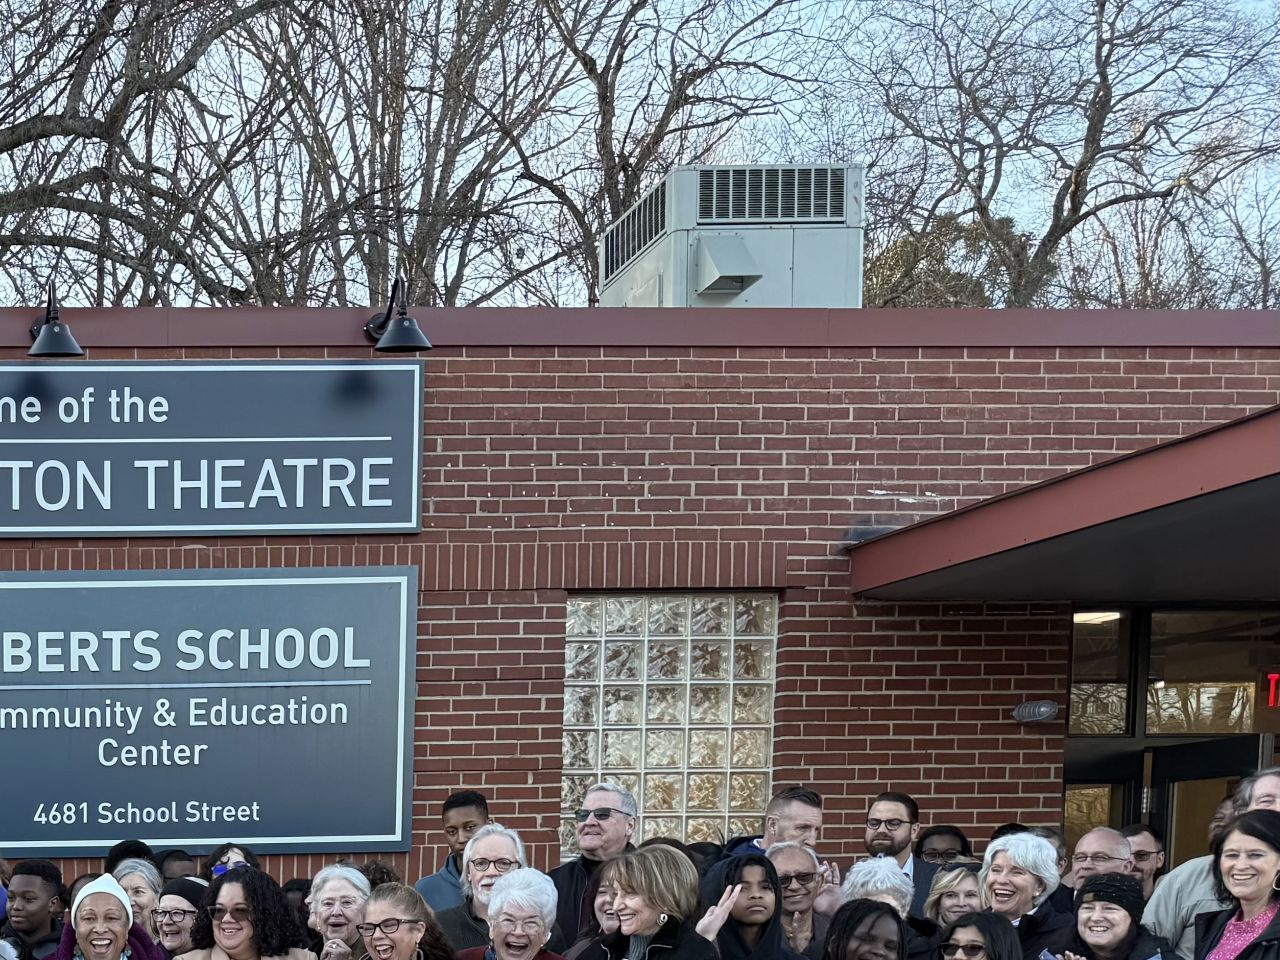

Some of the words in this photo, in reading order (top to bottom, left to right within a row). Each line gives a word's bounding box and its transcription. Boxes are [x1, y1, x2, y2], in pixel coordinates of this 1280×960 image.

[58, 386, 95, 424] of
[108, 386, 169, 423] the
[133, 457, 394, 510] THEATRE
[175, 626, 371, 671] SCHOOL
[1267, 673, 1280, 707] T
[153, 698, 177, 727] &
[189, 695, 348, 726] Education
[98, 738, 209, 767] Center
[33, 801, 88, 825] 4681
[97, 801, 179, 824] School
[185, 800, 260, 823] Street
